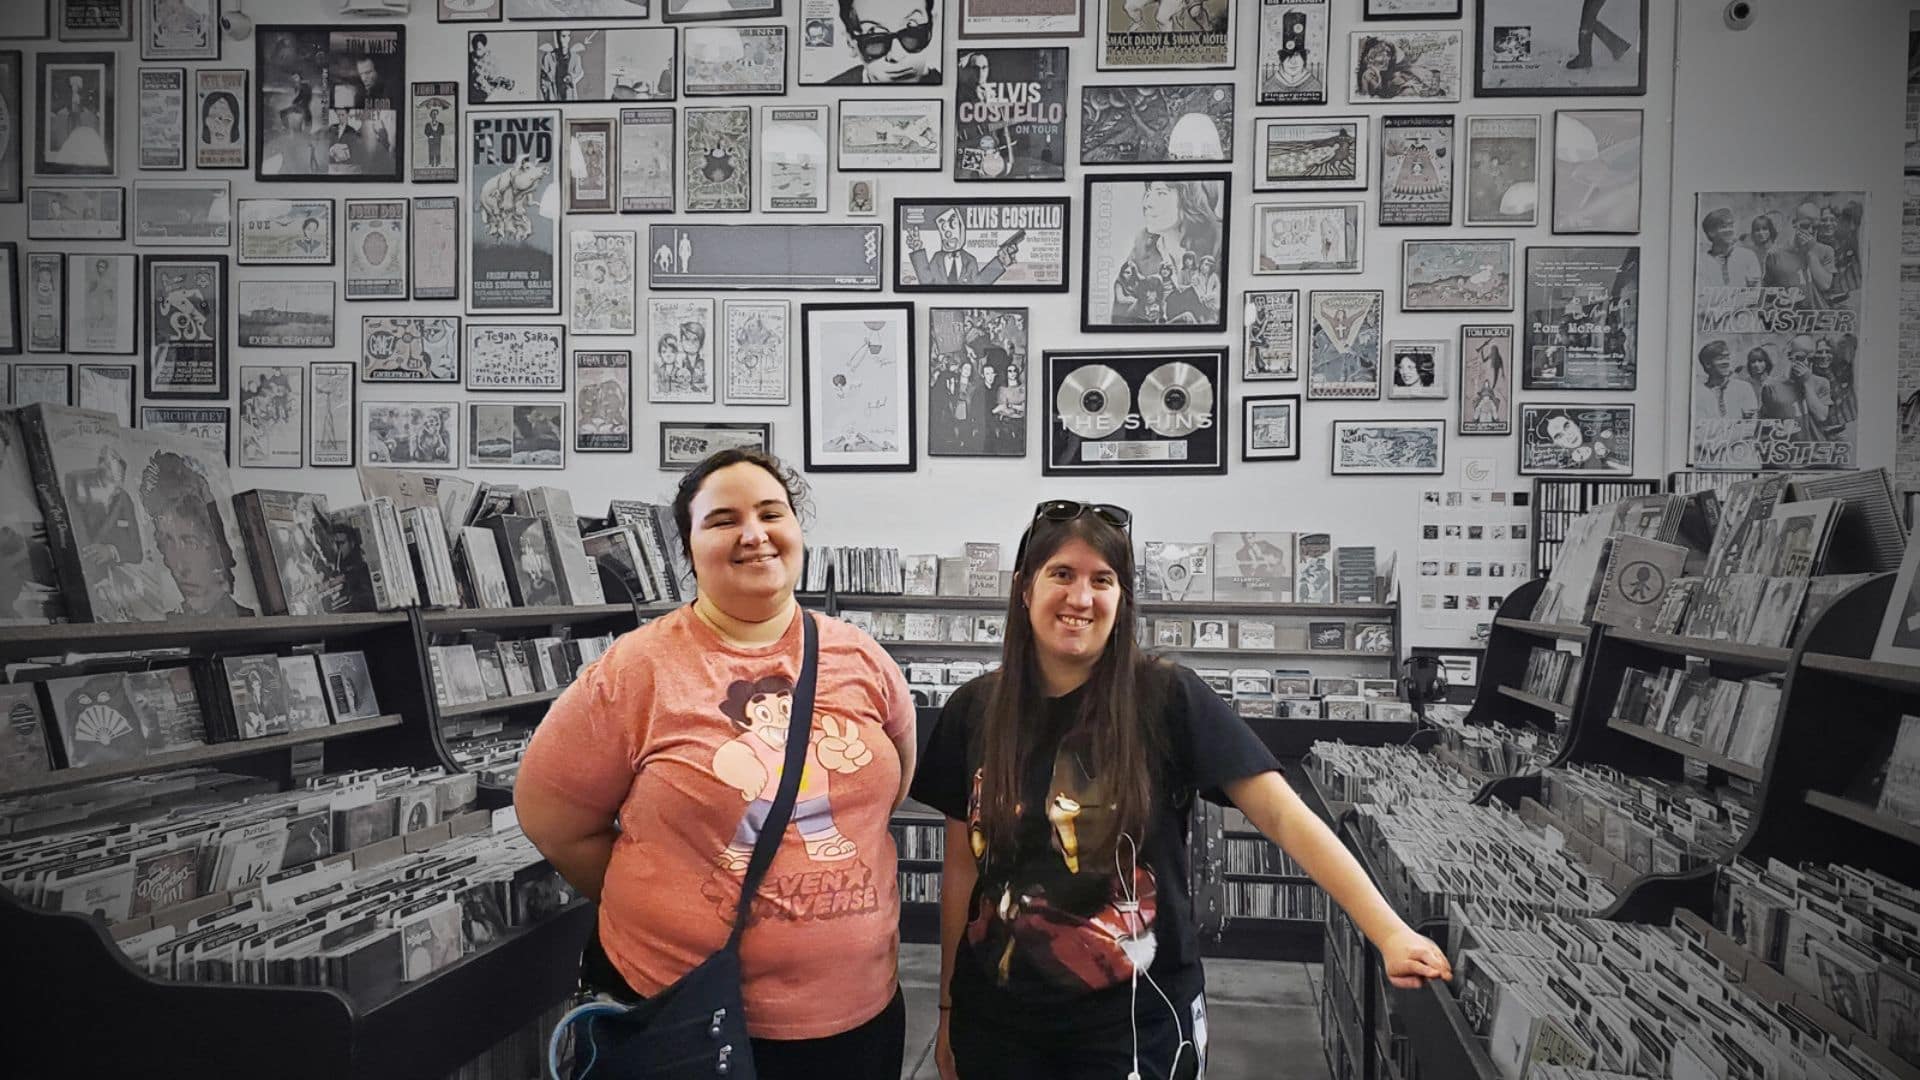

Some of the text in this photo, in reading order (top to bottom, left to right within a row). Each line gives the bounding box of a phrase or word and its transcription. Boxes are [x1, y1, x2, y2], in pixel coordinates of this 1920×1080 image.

[346, 38, 399, 53] TOM WAITS
[1134, 34, 1161, 46] DADDY
[1163, 34, 1169, 45] &
[984, 82, 1042, 104] ELVIS
[960, 101, 1063, 123] COSTELLO
[473, 118, 553, 133] PINK
[1015, 125, 1059, 134] ON TOUR
[473, 132, 552, 164] FLOYD
[966, 206, 1061, 228] ELVIS COSTELLO
[1533, 321, 1612, 334] Tom McRae
[1703, 310, 1857, 333] MONSTER
[1057, 412, 1214, 430] THE SHINS
[1698, 441, 1850, 465] MONSTER
